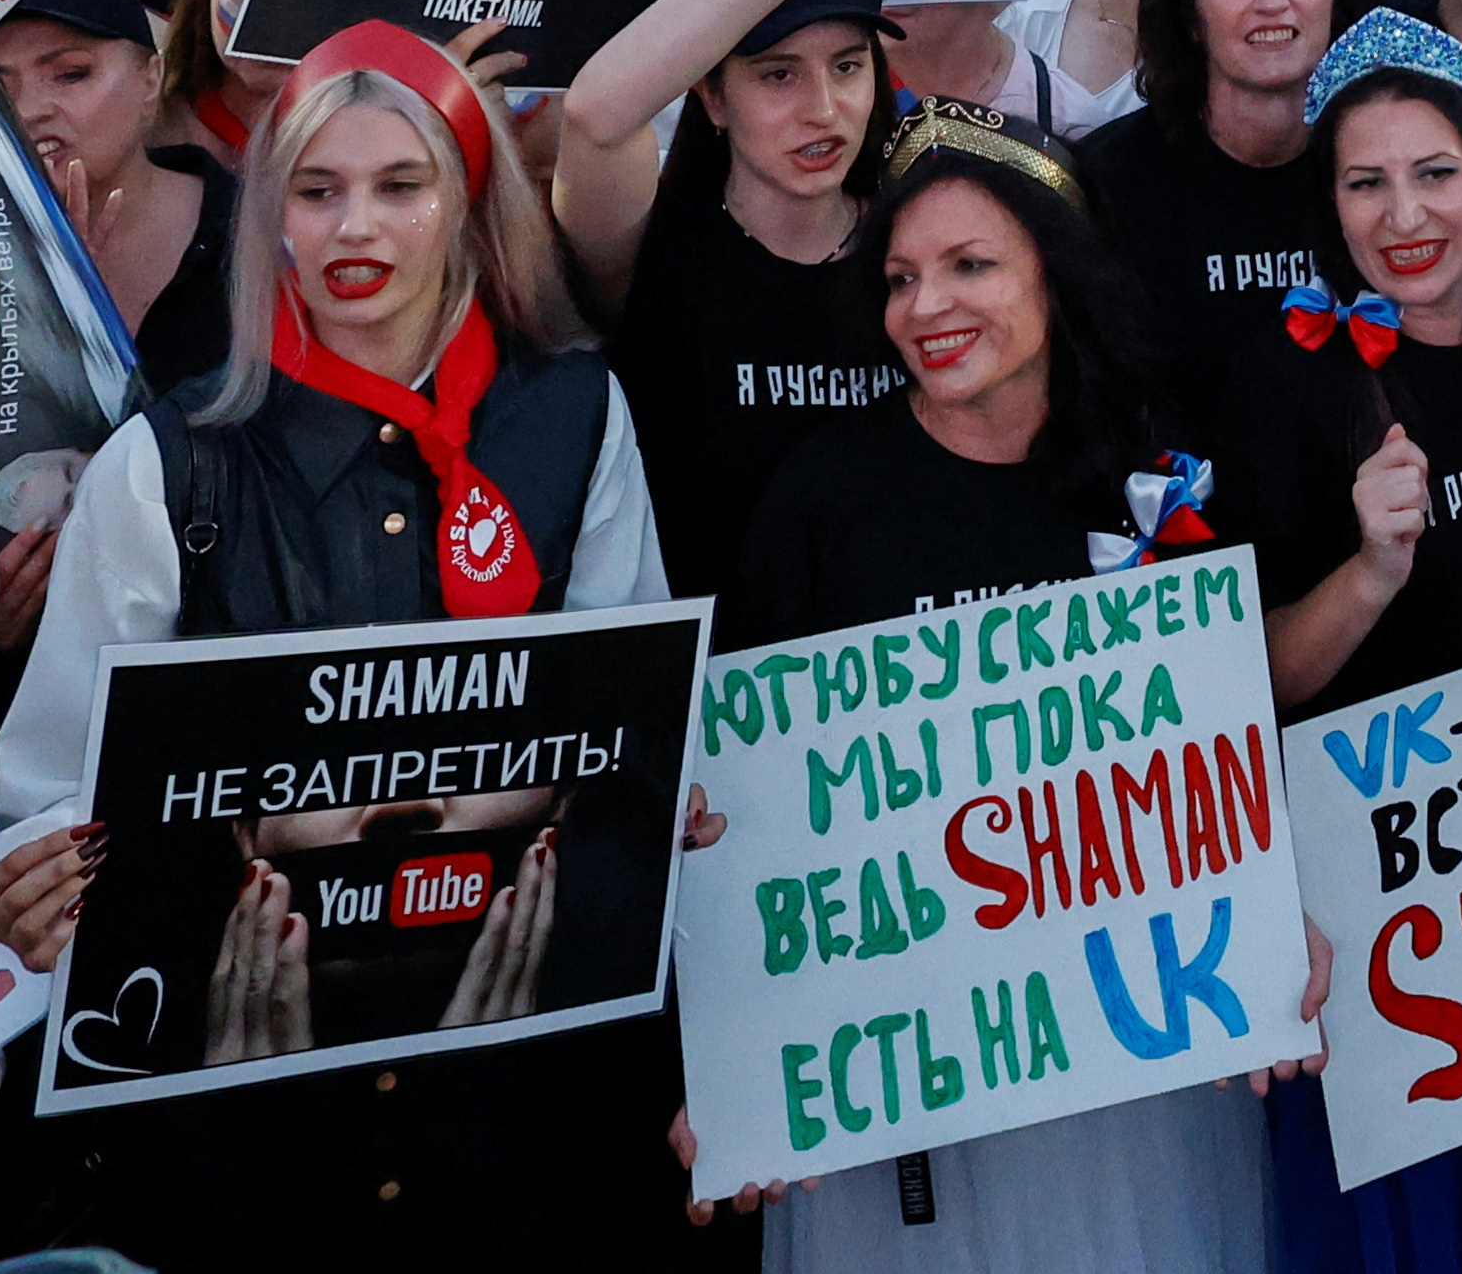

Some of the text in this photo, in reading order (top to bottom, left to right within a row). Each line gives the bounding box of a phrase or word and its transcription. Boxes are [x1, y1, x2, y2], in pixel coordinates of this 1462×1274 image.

[1207, 254, 1225, 292] Я
[737, 363, 755, 406] Я
[976, 565, 1245, 684] СКАЖЕМ
[304, 650, 530, 725] SHAMAN
[161, 726, 624, 822] НЕ ЗАПРЕТИТЬ!
[806, 663, 1183, 836] МЫ ПОКА
[319, 866, 484, 928] You Tube
[755, 723, 1271, 976] ВЕДЬ SHAMAN
[781, 896, 1251, 1152] ЕСТЬ НА VK
